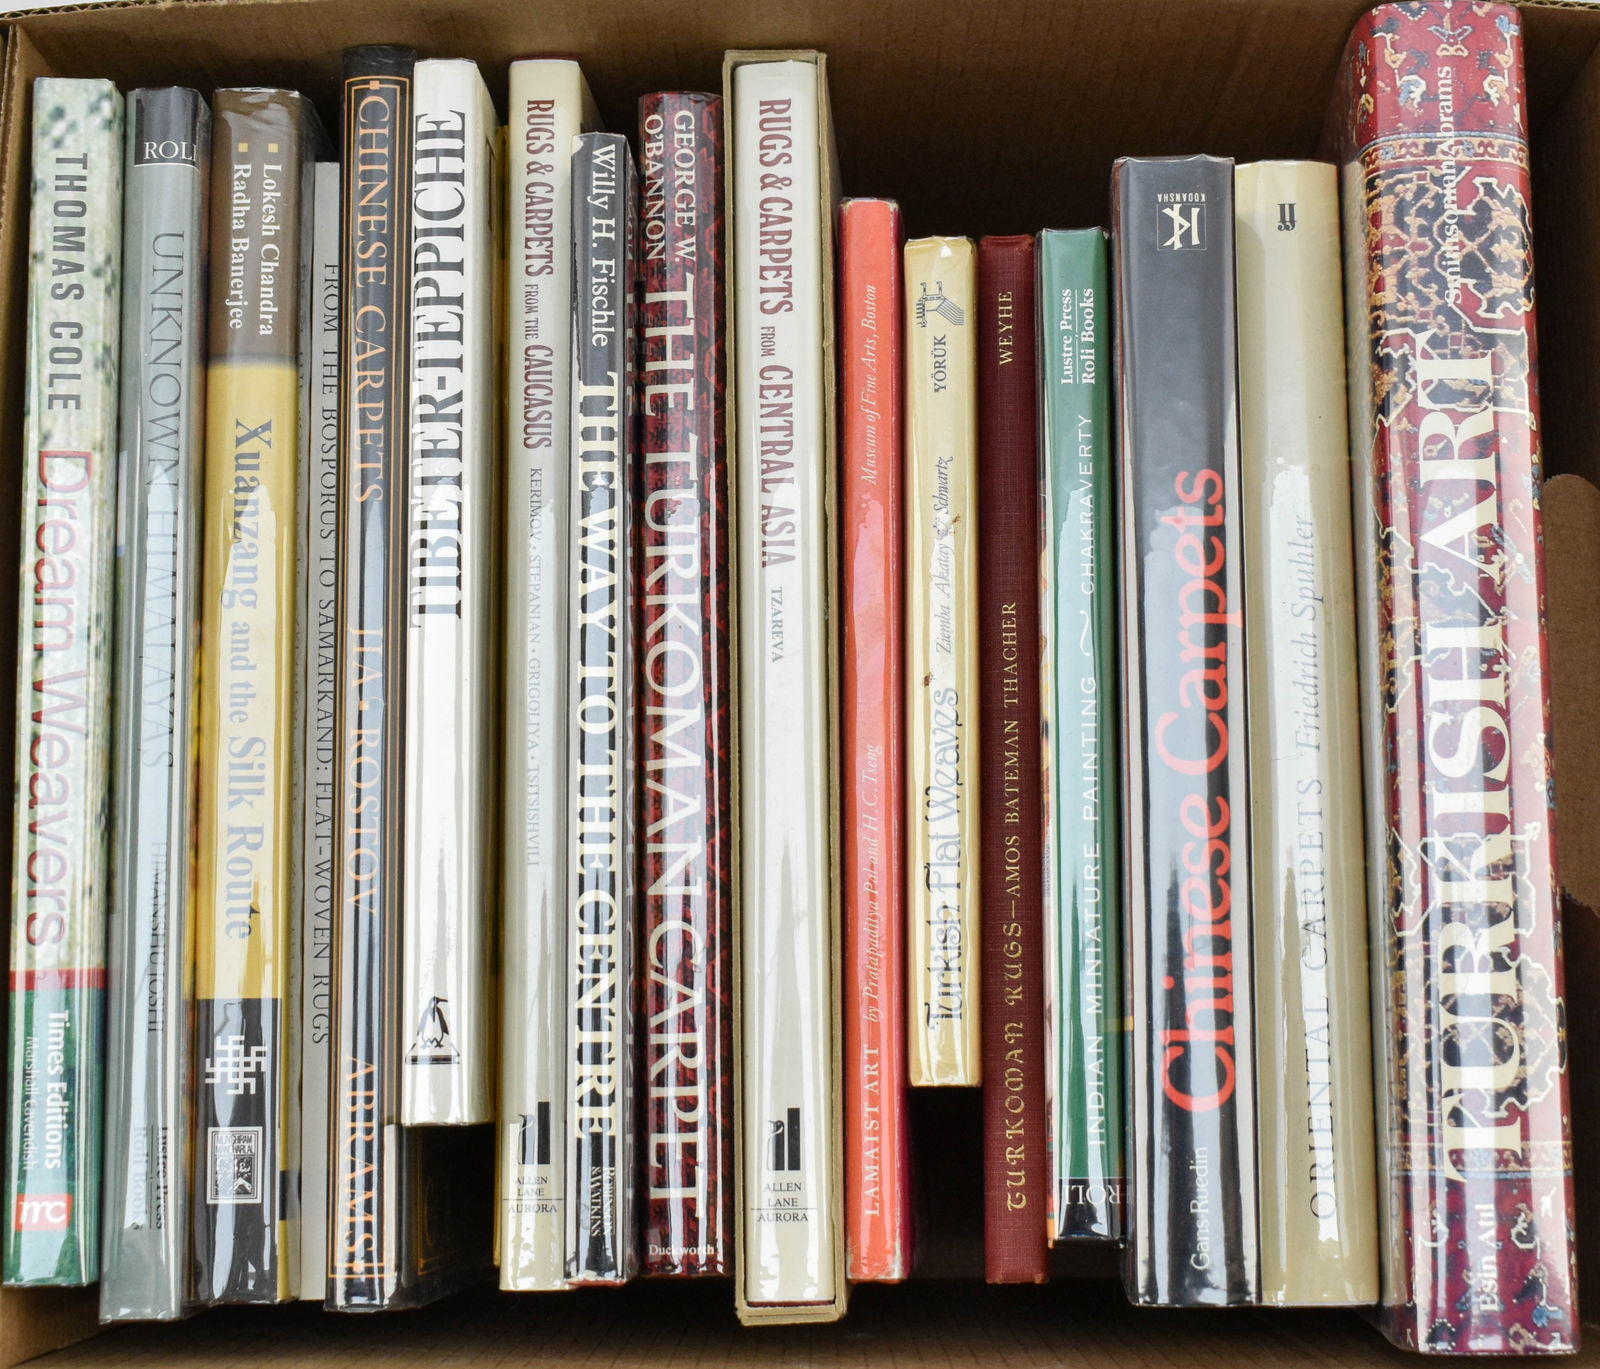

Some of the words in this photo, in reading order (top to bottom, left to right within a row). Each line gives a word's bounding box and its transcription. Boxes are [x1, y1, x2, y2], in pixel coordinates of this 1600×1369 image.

[525, 99, 556, 156] RUGS
[527, 160, 554, 174] &
[672, 109, 696, 229] GEORGE
[758, 97, 793, 169] RUGS
[232, 162, 252, 230] Radha
[261, 162, 282, 237] Lokesh
[355, 95, 390, 289] CHINESE
[587, 143, 616, 210] Willy
[759, 173, 792, 191] &
[1157, 192, 1206, 203] KODANSHA
[52, 152, 88, 301] THOMAS
[524, 179, 555, 278] CARPETS
[591, 218, 615, 248] H.
[672, 236, 697, 263] W.
[759, 196, 794, 315] CARPETS
[225, 238, 250, 331] Banerjee
[258, 241, 281, 336] Chandra
[323, 263, 340, 333] FROM
[524, 284, 539, 315] FROM
[524, 316, 538, 340] THE
[591, 258, 615, 348] Fischle
[861, 286, 877, 333] Boston
[999, 289, 1014, 366] WEYHE
[1060, 288, 1073, 331] Press
[1080, 288, 1097, 344] Books
[47, 321, 83, 411] COLE
[146, 232, 185, 490] UNKNOWN
[411, 110, 467, 629] TIBETER-TEPPICHE
[643, 271, 697, 419] THE
[760, 325, 776, 357] FROM
[861, 334, 879, 373] Arts,
[932, 333, 948, 393] YÖRÜK
[1060, 334, 1074, 386] Lustre
[1080, 348, 1096, 386] Roli
[352, 303, 387, 504] CARPETS
[523, 344, 554, 449] CAUCASUS
[578, 370, 620, 492] THE
[759, 364, 795, 494] CENTRAL
[860, 374, 877, 406] Fine
[860, 405, 881, 422] of
[319, 405, 339, 540] BOSPORUS
[860, 424, 878, 486] Museum
[932, 455, 955, 516] Schwartz
[1414, 327, 1505, 588] ART
[222, 418, 273, 610] Xuanzang
[761, 504, 797, 569] ASIA
[1078, 413, 1097, 596] CHAKRAVERTY
[33, 449, 93, 652] Dream
[577, 504, 618, 640] WAY
[934, 542, 954, 600] Akatay
[1287, 513, 1325, 622] Spuhler
[142, 509, 178, 768] HIMALAYAS
[230, 622, 257, 672] and
[346, 628, 384, 688] JIA
[643, 432, 704, 899] TURKOMAN
[770, 585, 785, 664] TZAREVA
[935, 604, 952, 656] Ziemba
[1002, 601, 1019, 708] THACHER
[1155, 467, 1244, 778] Carpets
[229, 680, 256, 724] the
[577, 651, 619, 735] TO
[1290, 632, 1321, 753] Friedrich
[227, 735, 266, 811] Silk
[924, 686, 965, 824] Weaves
[1003, 719, 1020, 824] BATEMAN
[1080, 675, 1101, 822] PAINTING
[26, 668, 88, 948] Weavers
[346, 728, 381, 917] ROSTOV
[575, 748, 618, 876] THE
[224, 822, 264, 941] Route
[311, 781, 333, 960] FLAT-WOVEN
[925, 831, 962, 894] Flat
[1296, 776, 1329, 973] CARPETS
[1425, 617, 1525, 1184] TURKISH
[1084, 841, 1103, 1013] MINIATURE
[1160, 793, 1238, 1114] Chinese
[47, 1009, 71, 1076] Times
[311, 974, 330, 1045] RUGS
[574, 888, 618, 1140] CENTRE
[647, 917, 704, 1219] CARPET
[862, 1042, 880, 1096] ART
[1086, 1033, 1106, 1147] INDIAN
[1303, 995, 1338, 1221] ORIENTAL
[45, 1081, 70, 1170] Editions
[344, 1053, 379, 1254] ABRAMS
[862, 1101, 881, 1217] LAMAIST
[1003, 1020, 1028, 1212] TURKOMAN
[757, 1212, 809, 1222] AURORA
[763, 1182, 802, 1192] ALLEN
[767, 1197, 799, 1207] LANE
[1189, 1146, 1211, 1271] Gans-Ruedin
[648, 1243, 716, 1256] Ducworth
